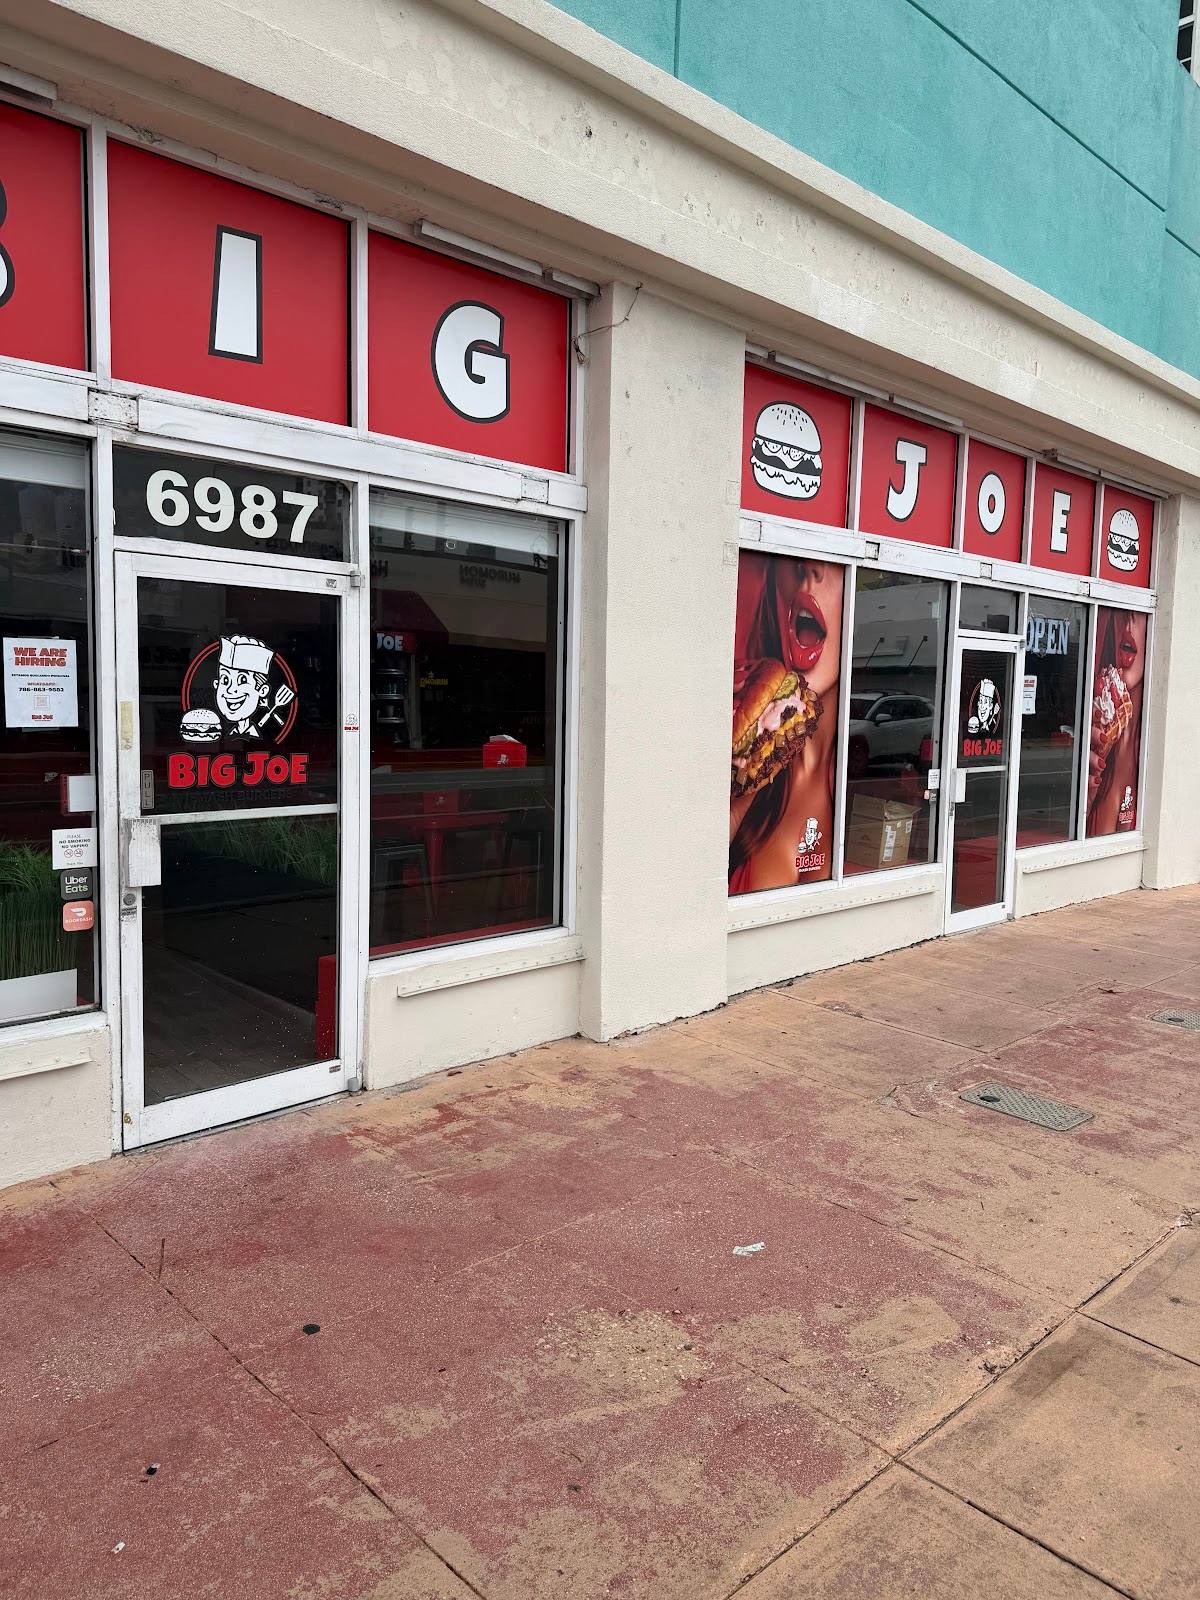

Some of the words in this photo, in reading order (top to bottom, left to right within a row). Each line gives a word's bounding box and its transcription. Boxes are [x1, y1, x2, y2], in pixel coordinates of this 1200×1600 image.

[886, 437, 1072, 553] JOE
[146, 469, 319, 543] 6987
[376, 632, 404, 651] JOE
[1025, 617, 1069, 655] OPEN
[13, 647, 37, 656] WE
[39, 648, 68, 658] ARE
[15, 657, 66, 667] HIRING
[963, 739, 982, 756] BIG
[983, 738, 1002, 756] JOE
[168, 752, 237, 788] BIG
[242, 751, 310, 786] JOE
[795, 855, 810, 869] BIG
[810, 853, 825, 867] JOE
[65, 876, 88, 885] Uber
[65, 884, 88, 894] Eats
